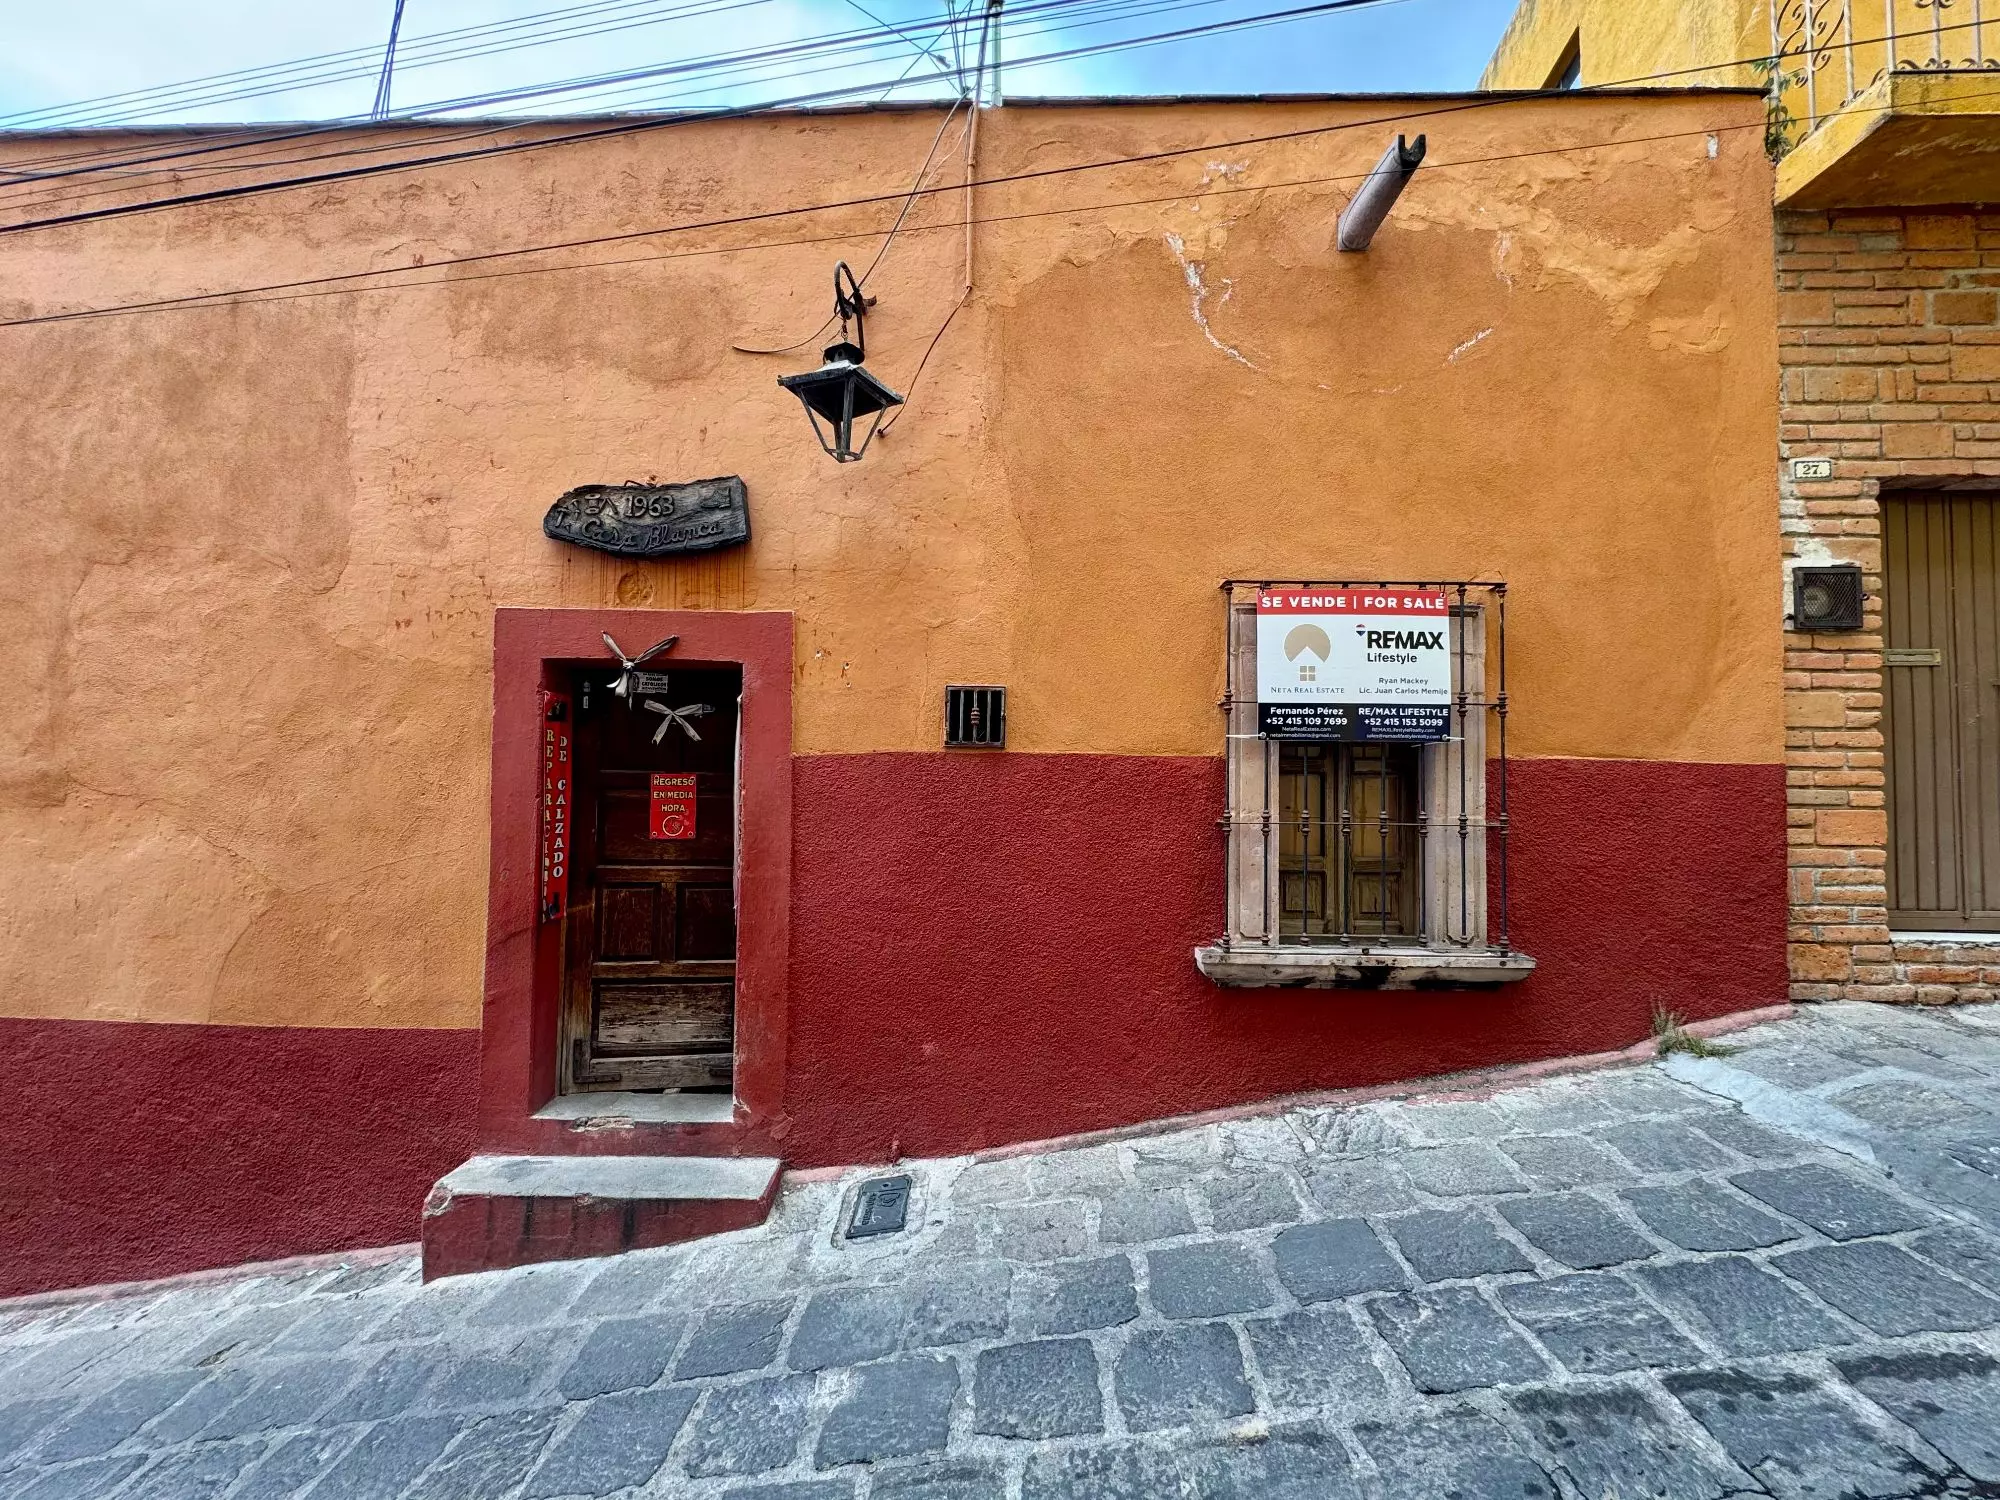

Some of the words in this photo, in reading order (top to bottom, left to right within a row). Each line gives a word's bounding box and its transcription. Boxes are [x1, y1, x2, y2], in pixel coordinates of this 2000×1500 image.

[623, 495, 675, 518] 1963
[644, 521, 724, 552] Blanca
[1261, 596, 1283, 608] SE
[1288, 596, 1347, 608] VENDE
[1364, 596, 1398, 609] FOR
[1403, 597, 1445, 610] SALE
[1367, 652, 1418, 665] Lifestyle
[1378, 677, 1398, 685] Ryan
[1400, 677, 1429, 686] Mackey
[1395, 687, 1419, 695] Carlos
[1421, 688, 1448, 696] Memije
[1270, 707, 1315, 715] Fernando
[1317, 706, 1344, 715] Pérez
[1358, 707, 1398, 717] RE/MAX
[1399, 708, 1449, 716] LIFESTYLE
[1266, 717, 1284, 725] +52
[1286, 717, 1302, 725] 415
[1304, 717, 1321, 725] 109
[1323, 717, 1348, 725] 7699
[1364, 718, 1382, 726] +52
[1383, 718, 1400, 726] 415
[1402, 718, 1417, 726] 153
[1419, 718, 1443, 727] 5099
[559, 736, 568, 762] DE
[653, 777, 695, 786] REGRESO
[653, 791, 665, 799] EN
[667, 791, 694, 799] MEDIA
[661, 804, 686, 812] HORA
[552, 779, 567, 878] CALZADO
